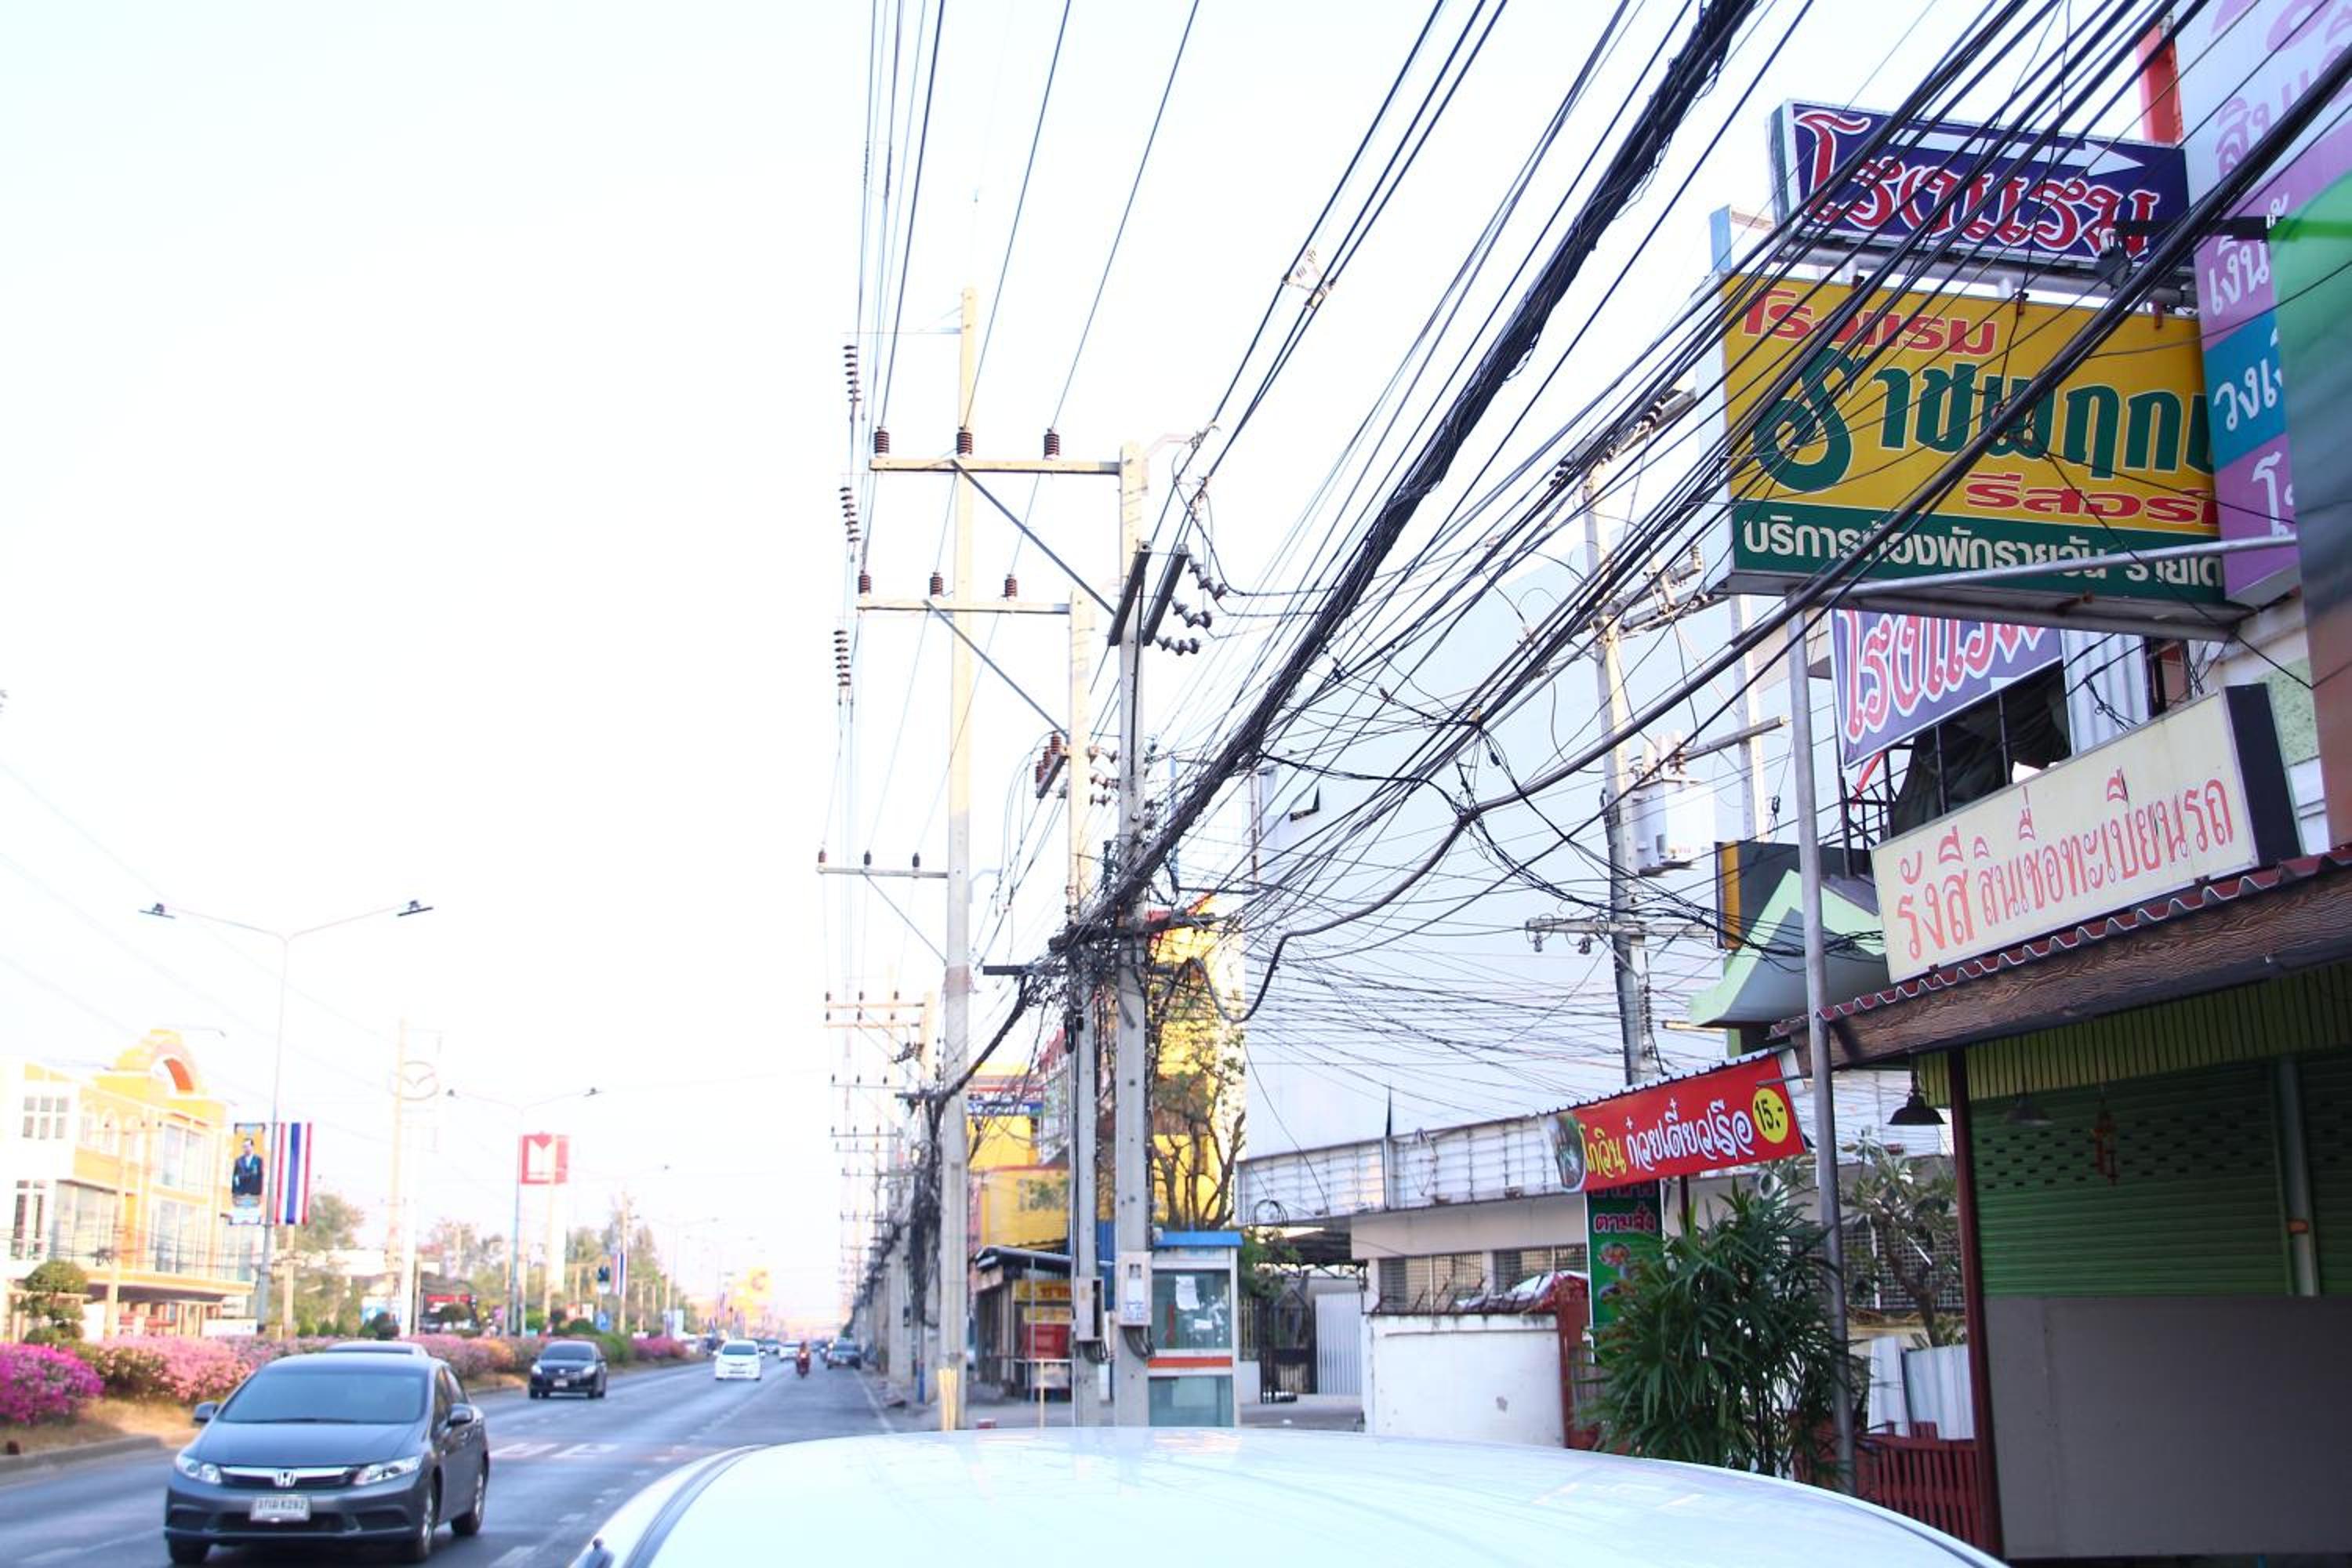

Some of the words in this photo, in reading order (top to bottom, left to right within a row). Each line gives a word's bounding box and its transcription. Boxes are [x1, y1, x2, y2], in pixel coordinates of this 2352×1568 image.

[1743, 287, 1996, 355] โรงแรม
[1835, 610, 2044, 743] โรงแร
[1897, 826, 1976, 960] รังสี
